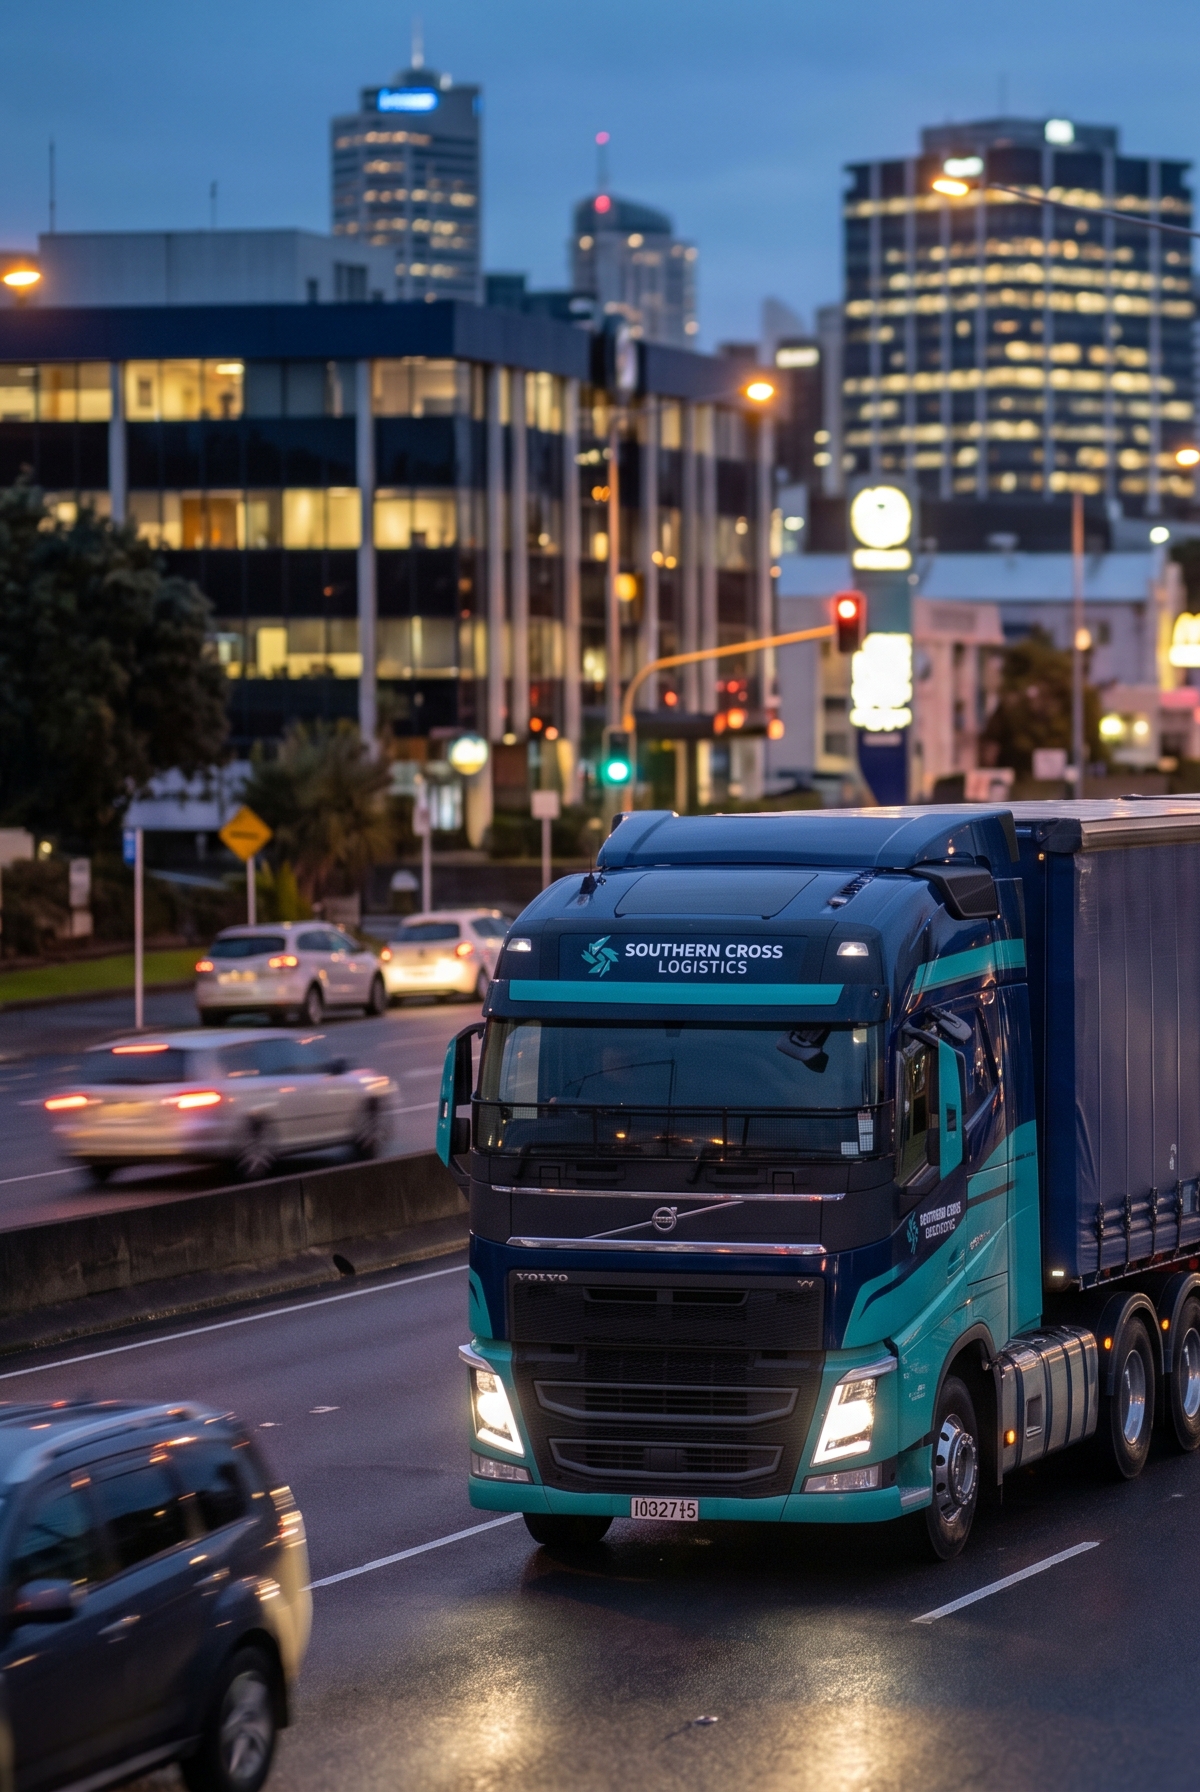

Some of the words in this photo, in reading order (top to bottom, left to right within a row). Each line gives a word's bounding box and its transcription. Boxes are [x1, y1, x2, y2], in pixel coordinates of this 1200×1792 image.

[625, 943, 721, 958] SOUTHERN
[725, 944, 783, 959] CROSS
[658, 960, 747, 974] LOGISTICS
[516, 1273, 569, 1282] VOLVO
